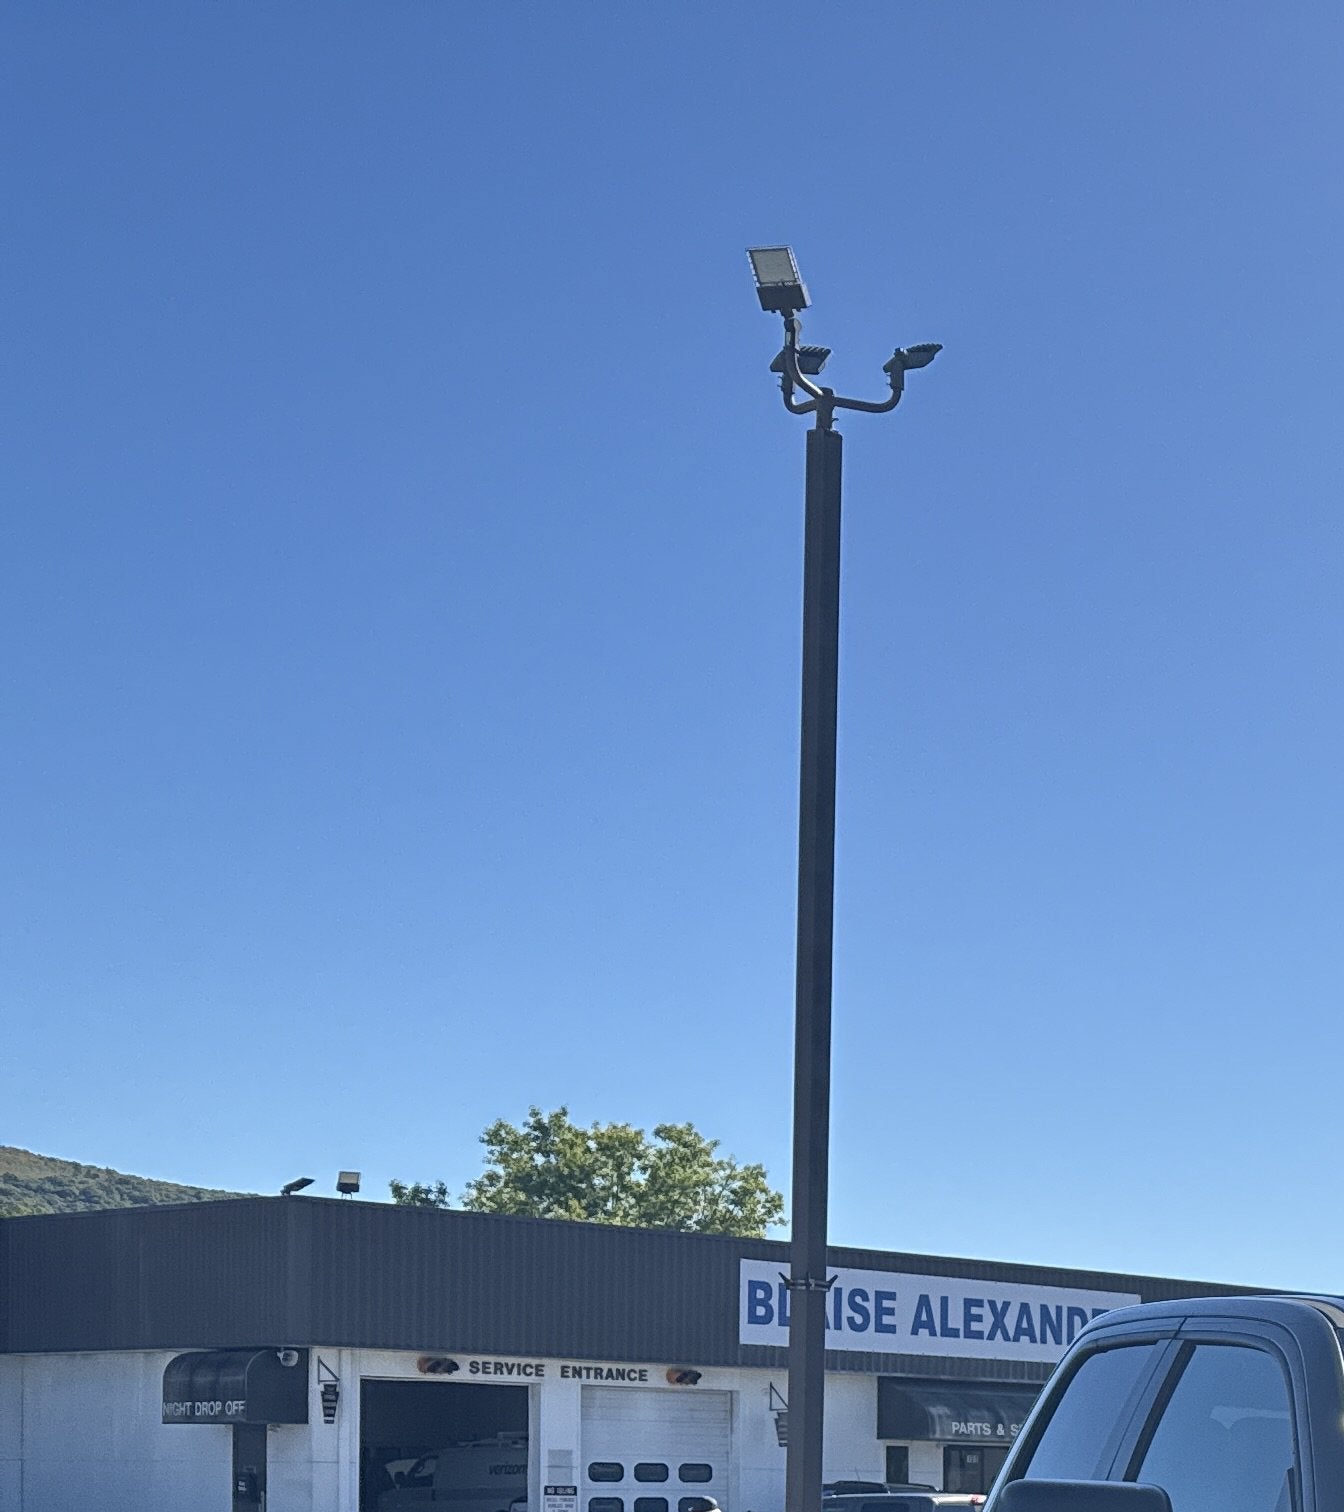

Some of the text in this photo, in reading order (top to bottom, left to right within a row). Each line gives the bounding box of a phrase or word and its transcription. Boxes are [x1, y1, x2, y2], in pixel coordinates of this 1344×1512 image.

[747, 1279, 897, 1334] BLISE
[469, 1361, 648, 1381] SERVICE ENTRANCE
[162, 1400, 246, 1416] NIGHT DROP OFF
[951, 1421, 992, 1436] PARTS
[996, 1423, 1005, 1436] &
